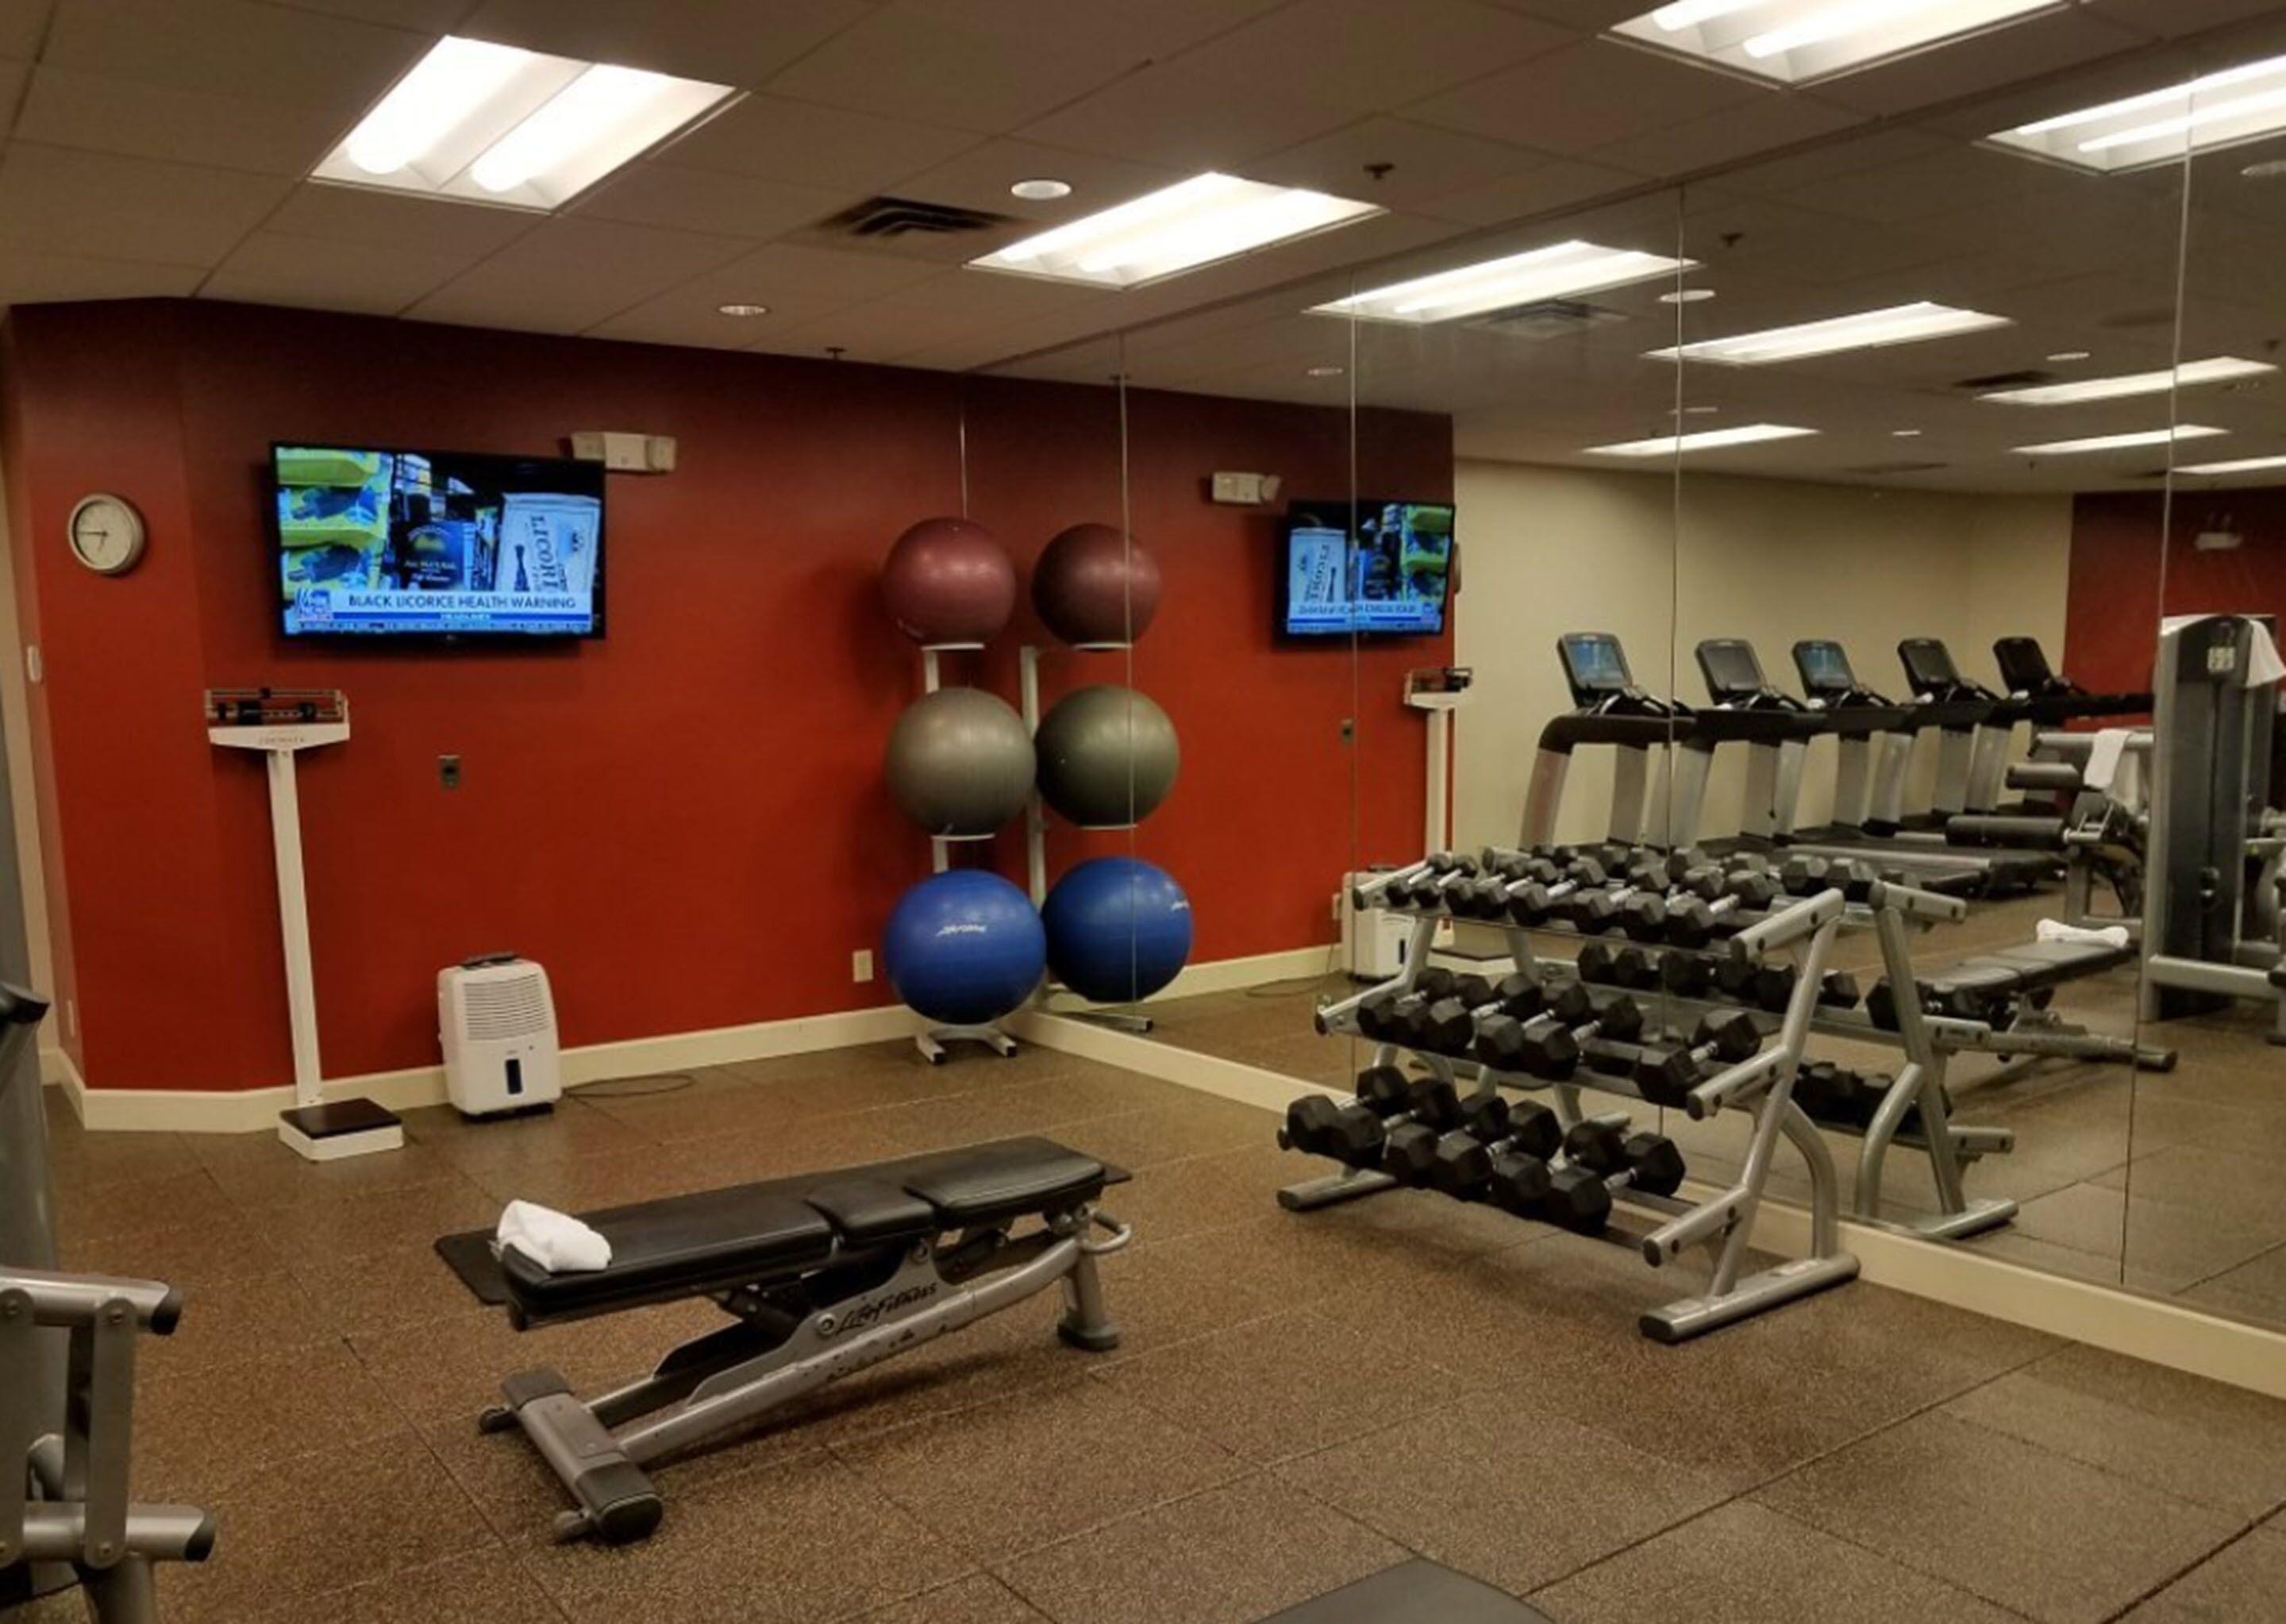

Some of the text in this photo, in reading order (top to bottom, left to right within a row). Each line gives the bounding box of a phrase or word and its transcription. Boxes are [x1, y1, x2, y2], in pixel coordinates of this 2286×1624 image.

[348, 594, 576, 609] BLACK LICORICE HEALTH WARNING
